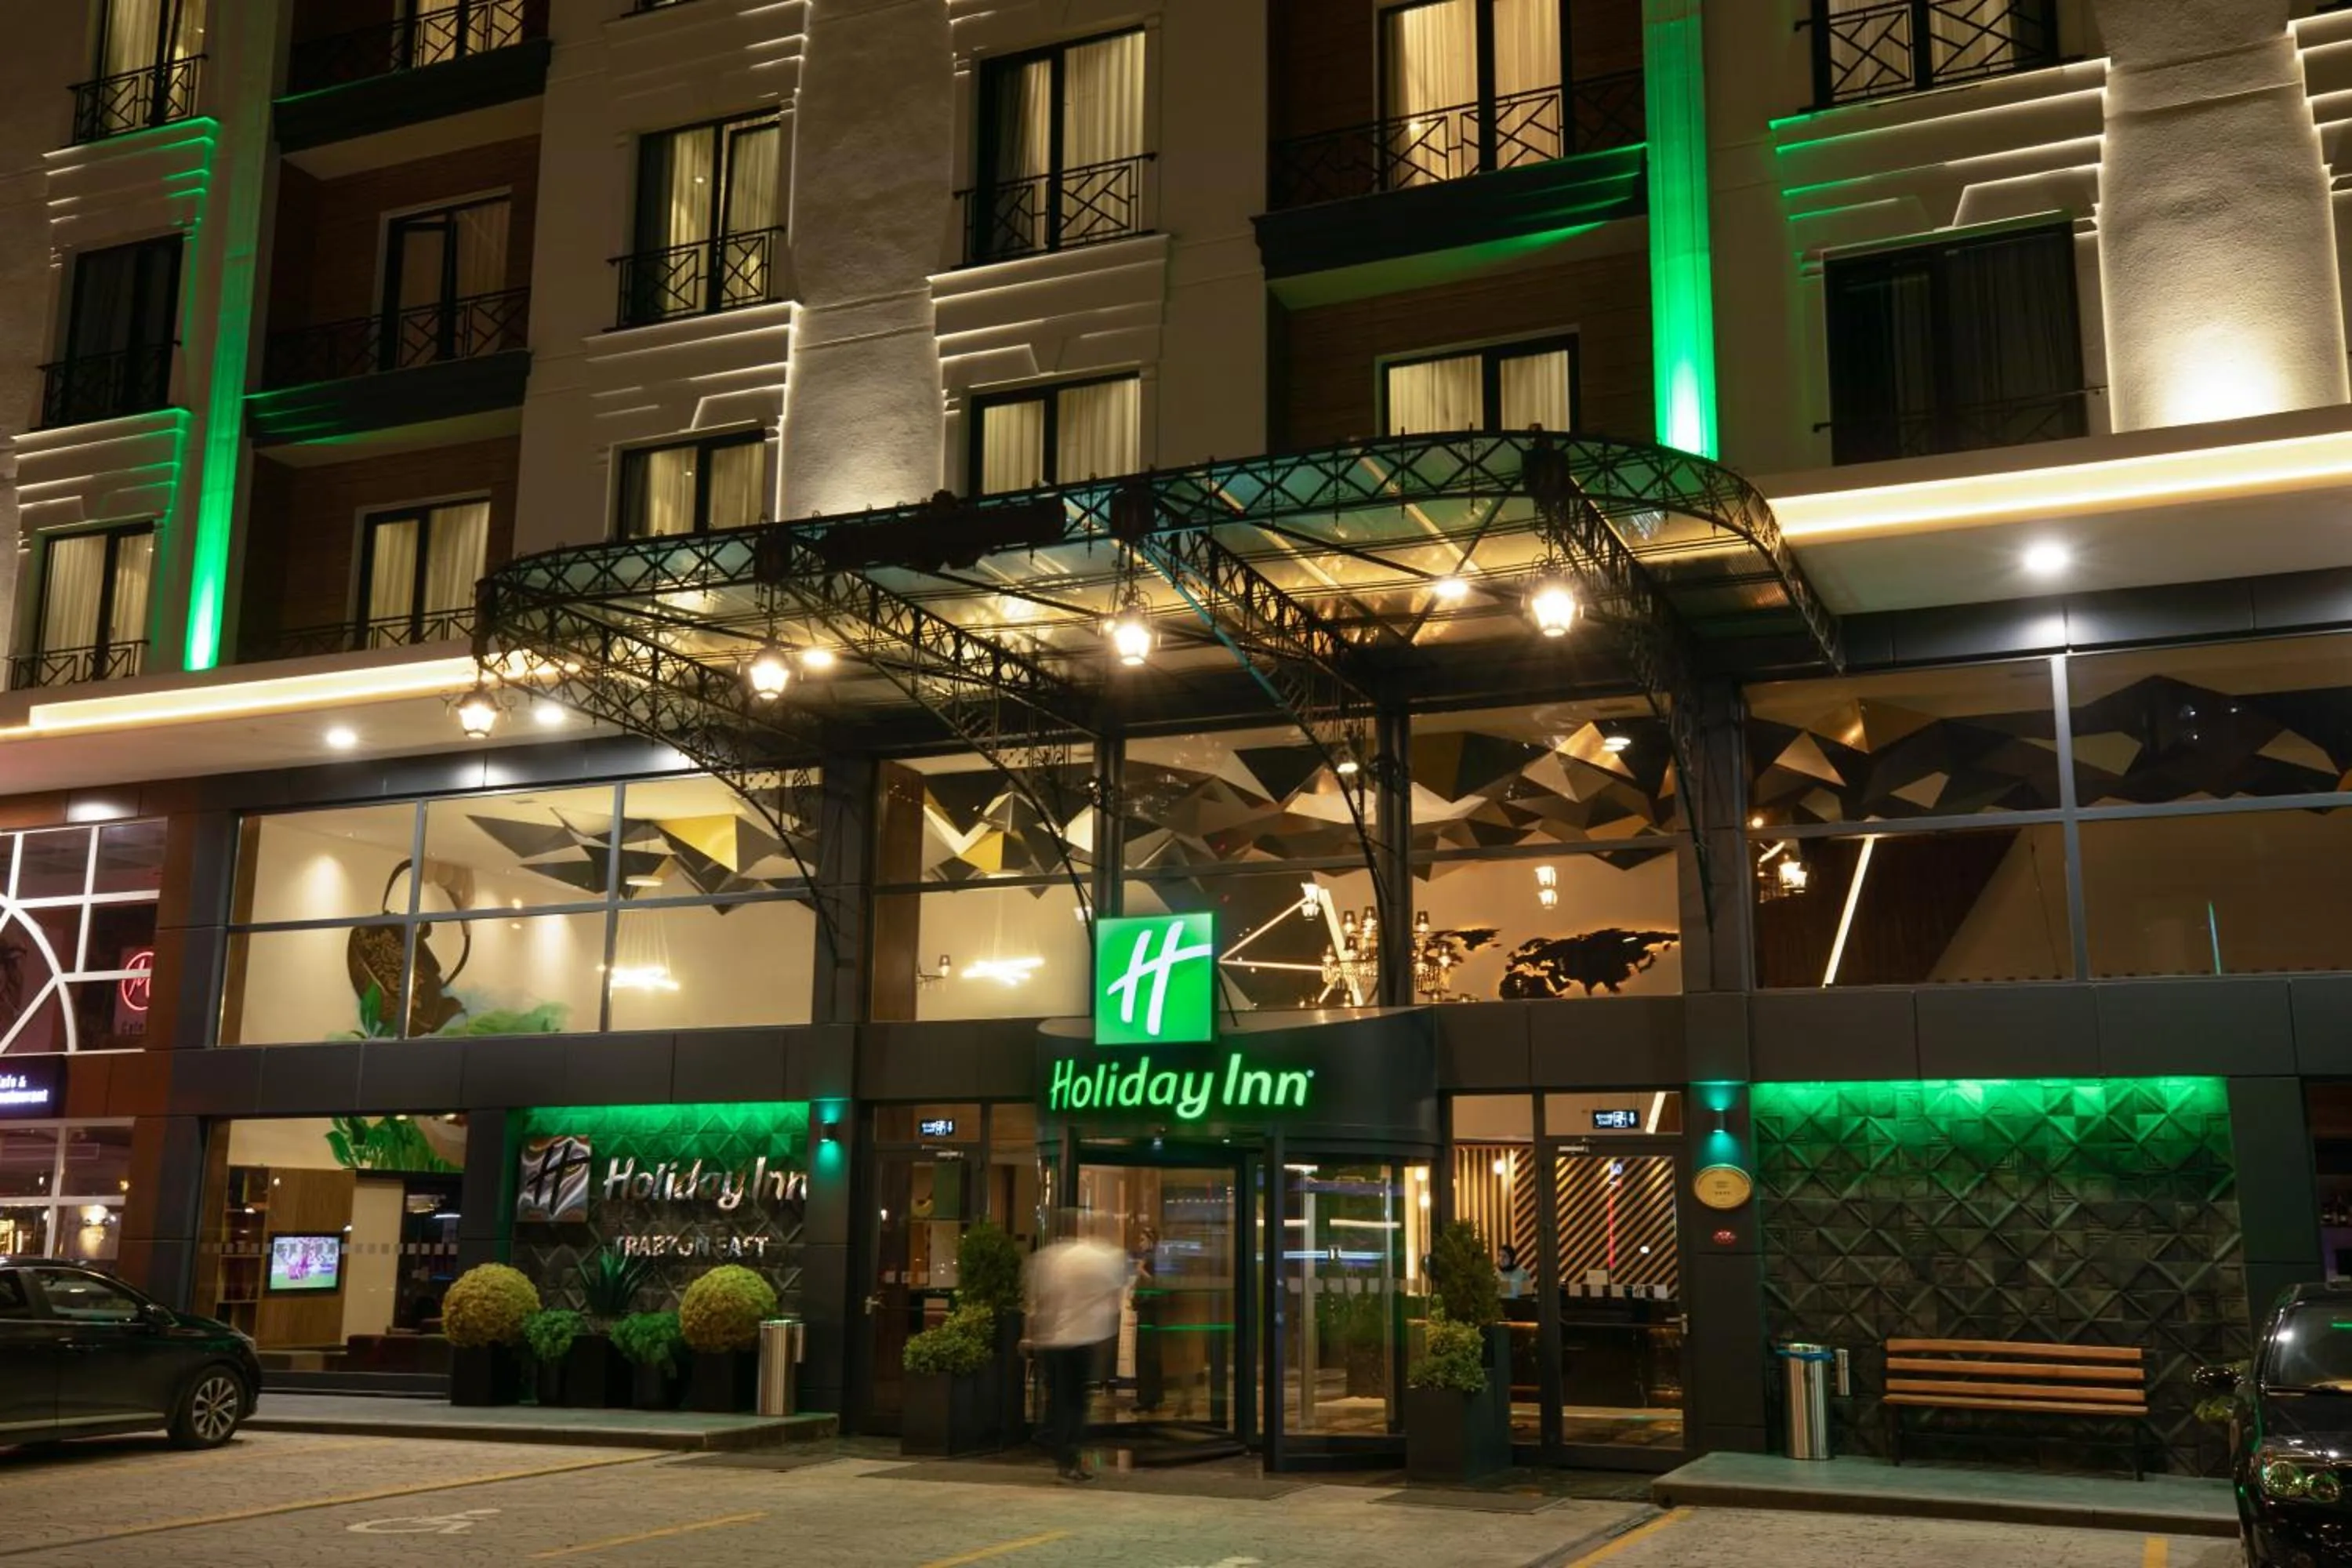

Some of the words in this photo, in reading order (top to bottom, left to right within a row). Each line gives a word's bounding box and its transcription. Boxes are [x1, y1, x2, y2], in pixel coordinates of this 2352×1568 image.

[1050, 1056, 1214, 1119] Holiday
[1223, 1054, 1308, 1105] Inn
[603, 1156, 745, 1210] Holiday
[752, 1156, 807, 1200] Inn
